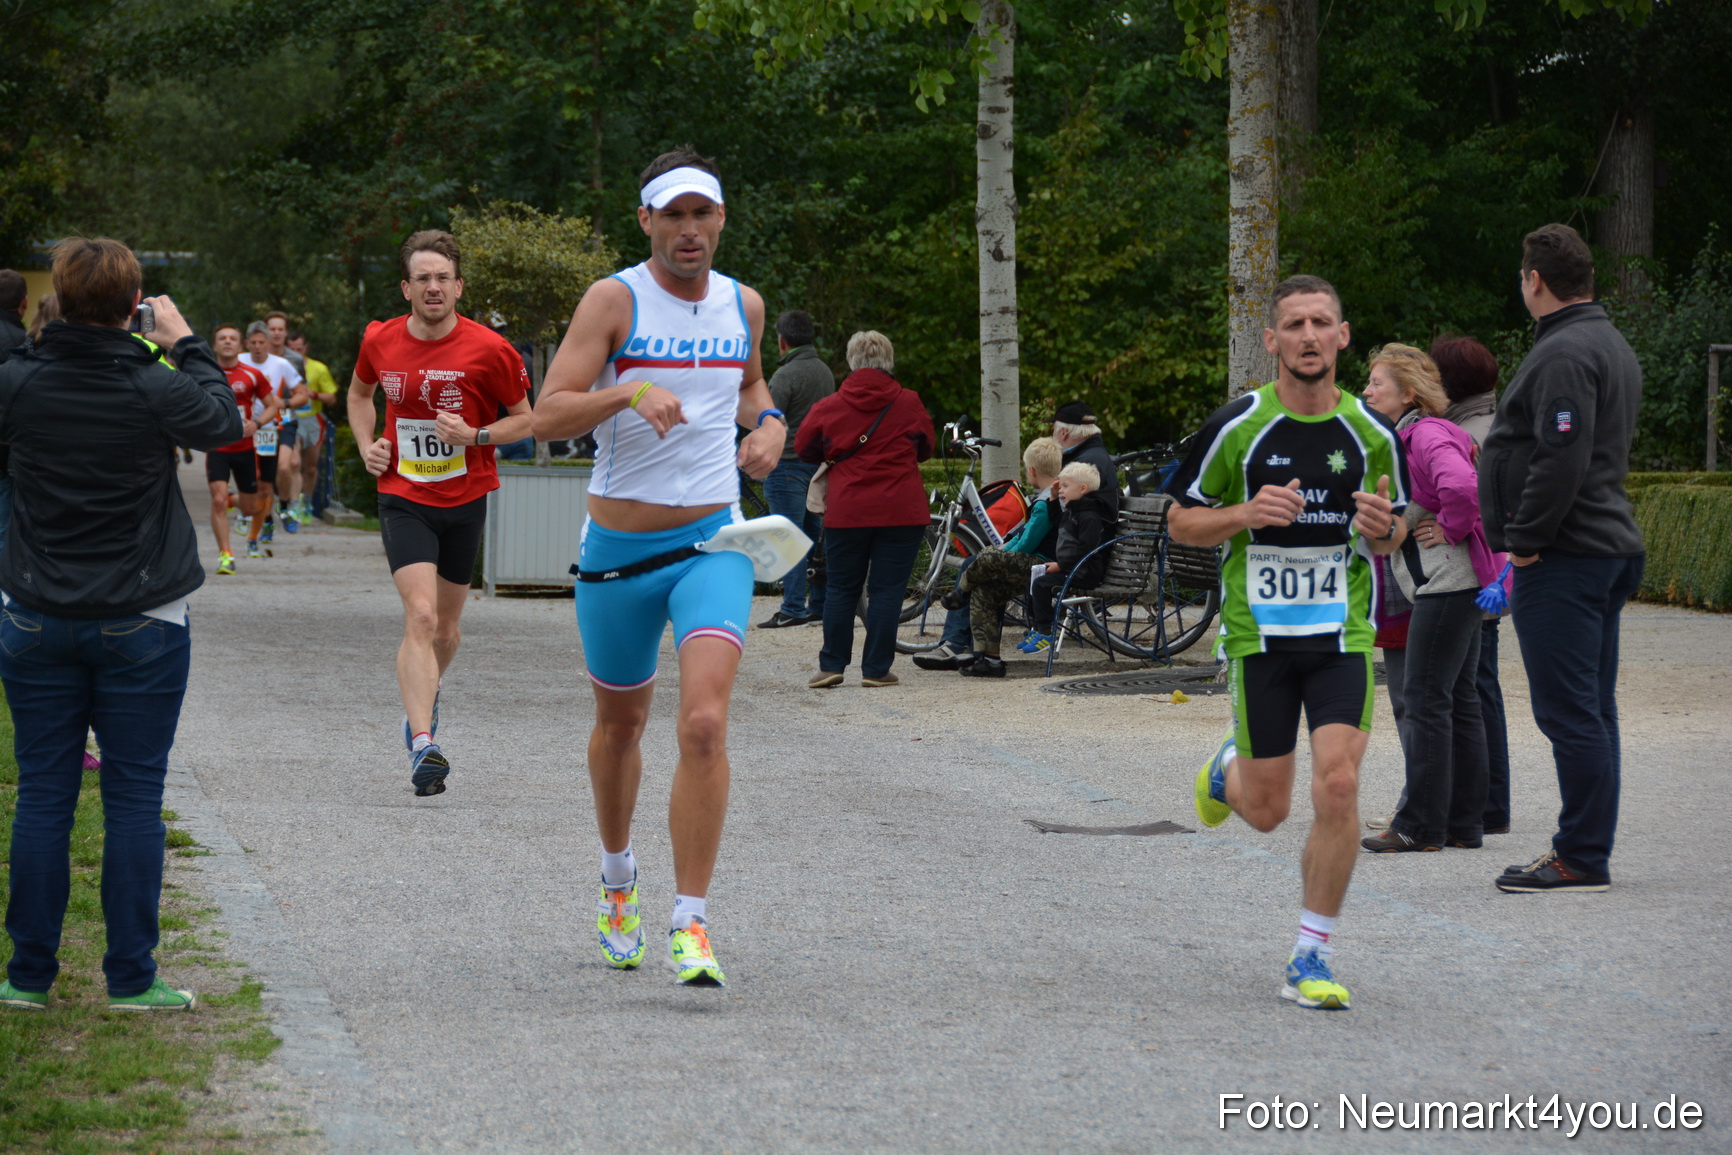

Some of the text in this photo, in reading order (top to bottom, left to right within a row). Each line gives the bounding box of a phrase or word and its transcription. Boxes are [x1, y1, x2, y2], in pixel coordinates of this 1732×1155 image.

[427, 369, 465, 377] NEUMARKTER
[397, 424, 418, 432] PARTL
[411, 434, 454, 457] 160
[414, 462, 451, 473] Michael
[1291, 510, 1348, 524] enbach
[974, 505, 1000, 547] KETTLER
[1250, 553, 1330, 564] PARTL Neumarkt
[1258, 566, 1338, 599] 3014
